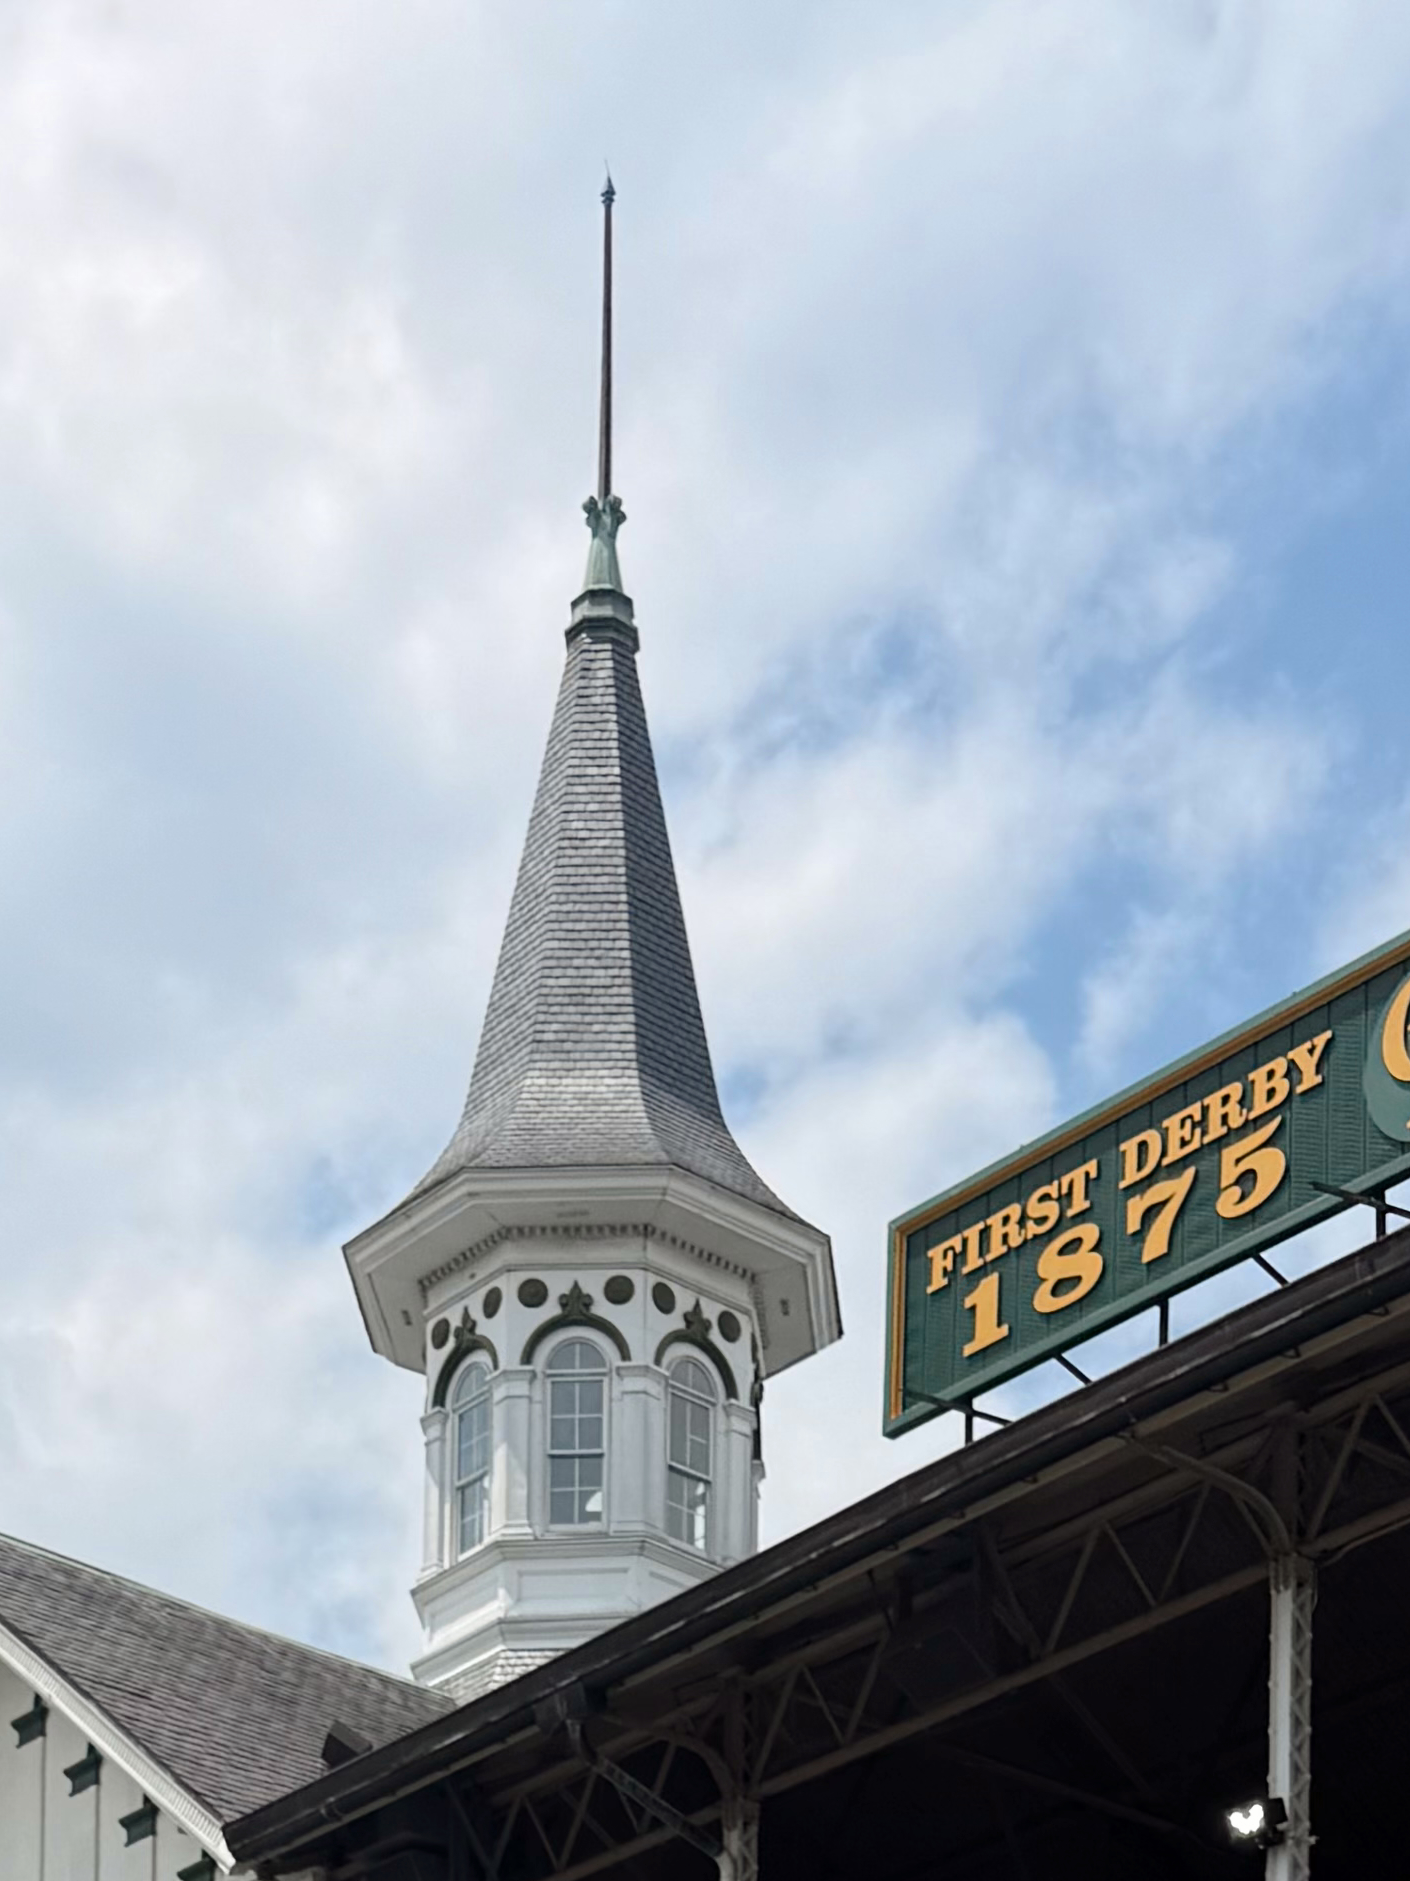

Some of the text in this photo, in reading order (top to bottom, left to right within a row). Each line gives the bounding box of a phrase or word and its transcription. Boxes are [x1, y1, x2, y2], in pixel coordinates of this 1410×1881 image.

[926, 1030, 1333, 1295] FIRST DERBY
[962, 1114, 1287, 1358] 1875
